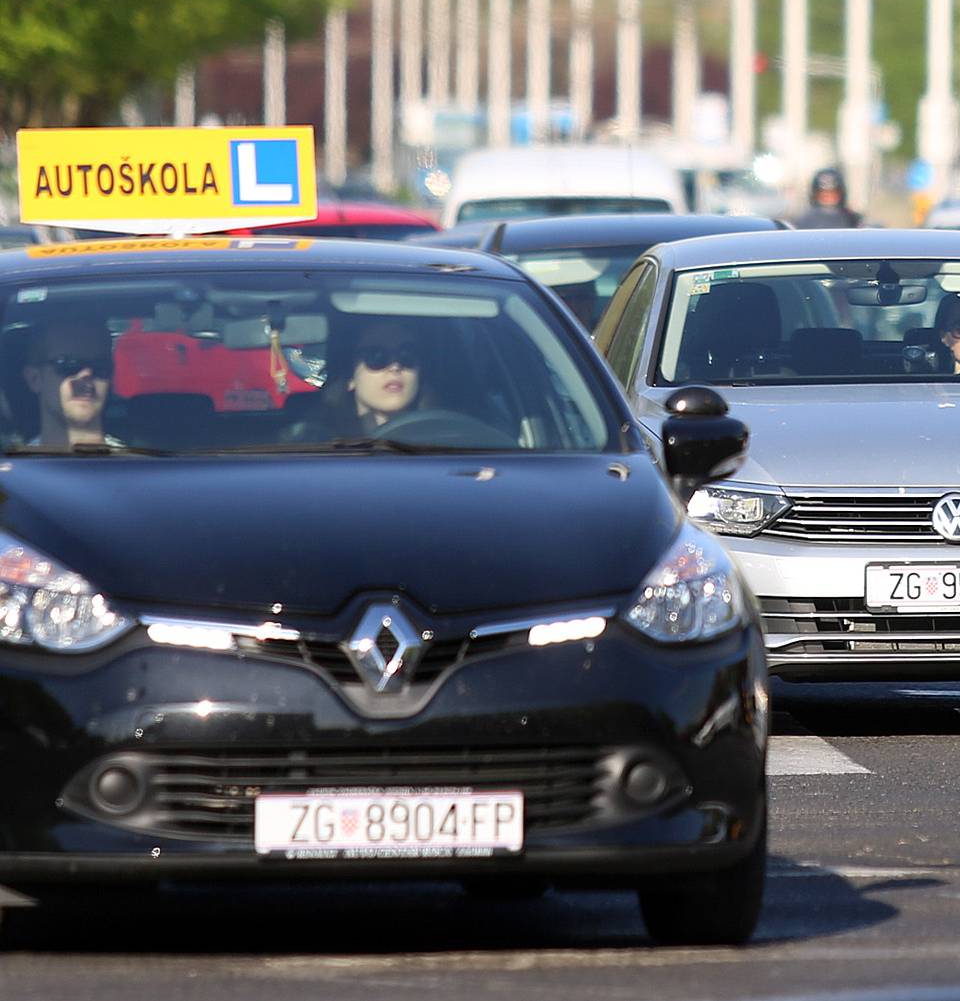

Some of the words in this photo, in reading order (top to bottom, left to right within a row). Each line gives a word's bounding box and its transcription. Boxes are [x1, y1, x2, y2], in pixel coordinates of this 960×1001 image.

[35, 156, 219, 198] AUTOŠKOLA
[237, 143, 292, 202] L
[890, 572, 921, 600] ZG
[290, 803, 335, 842] ZG
